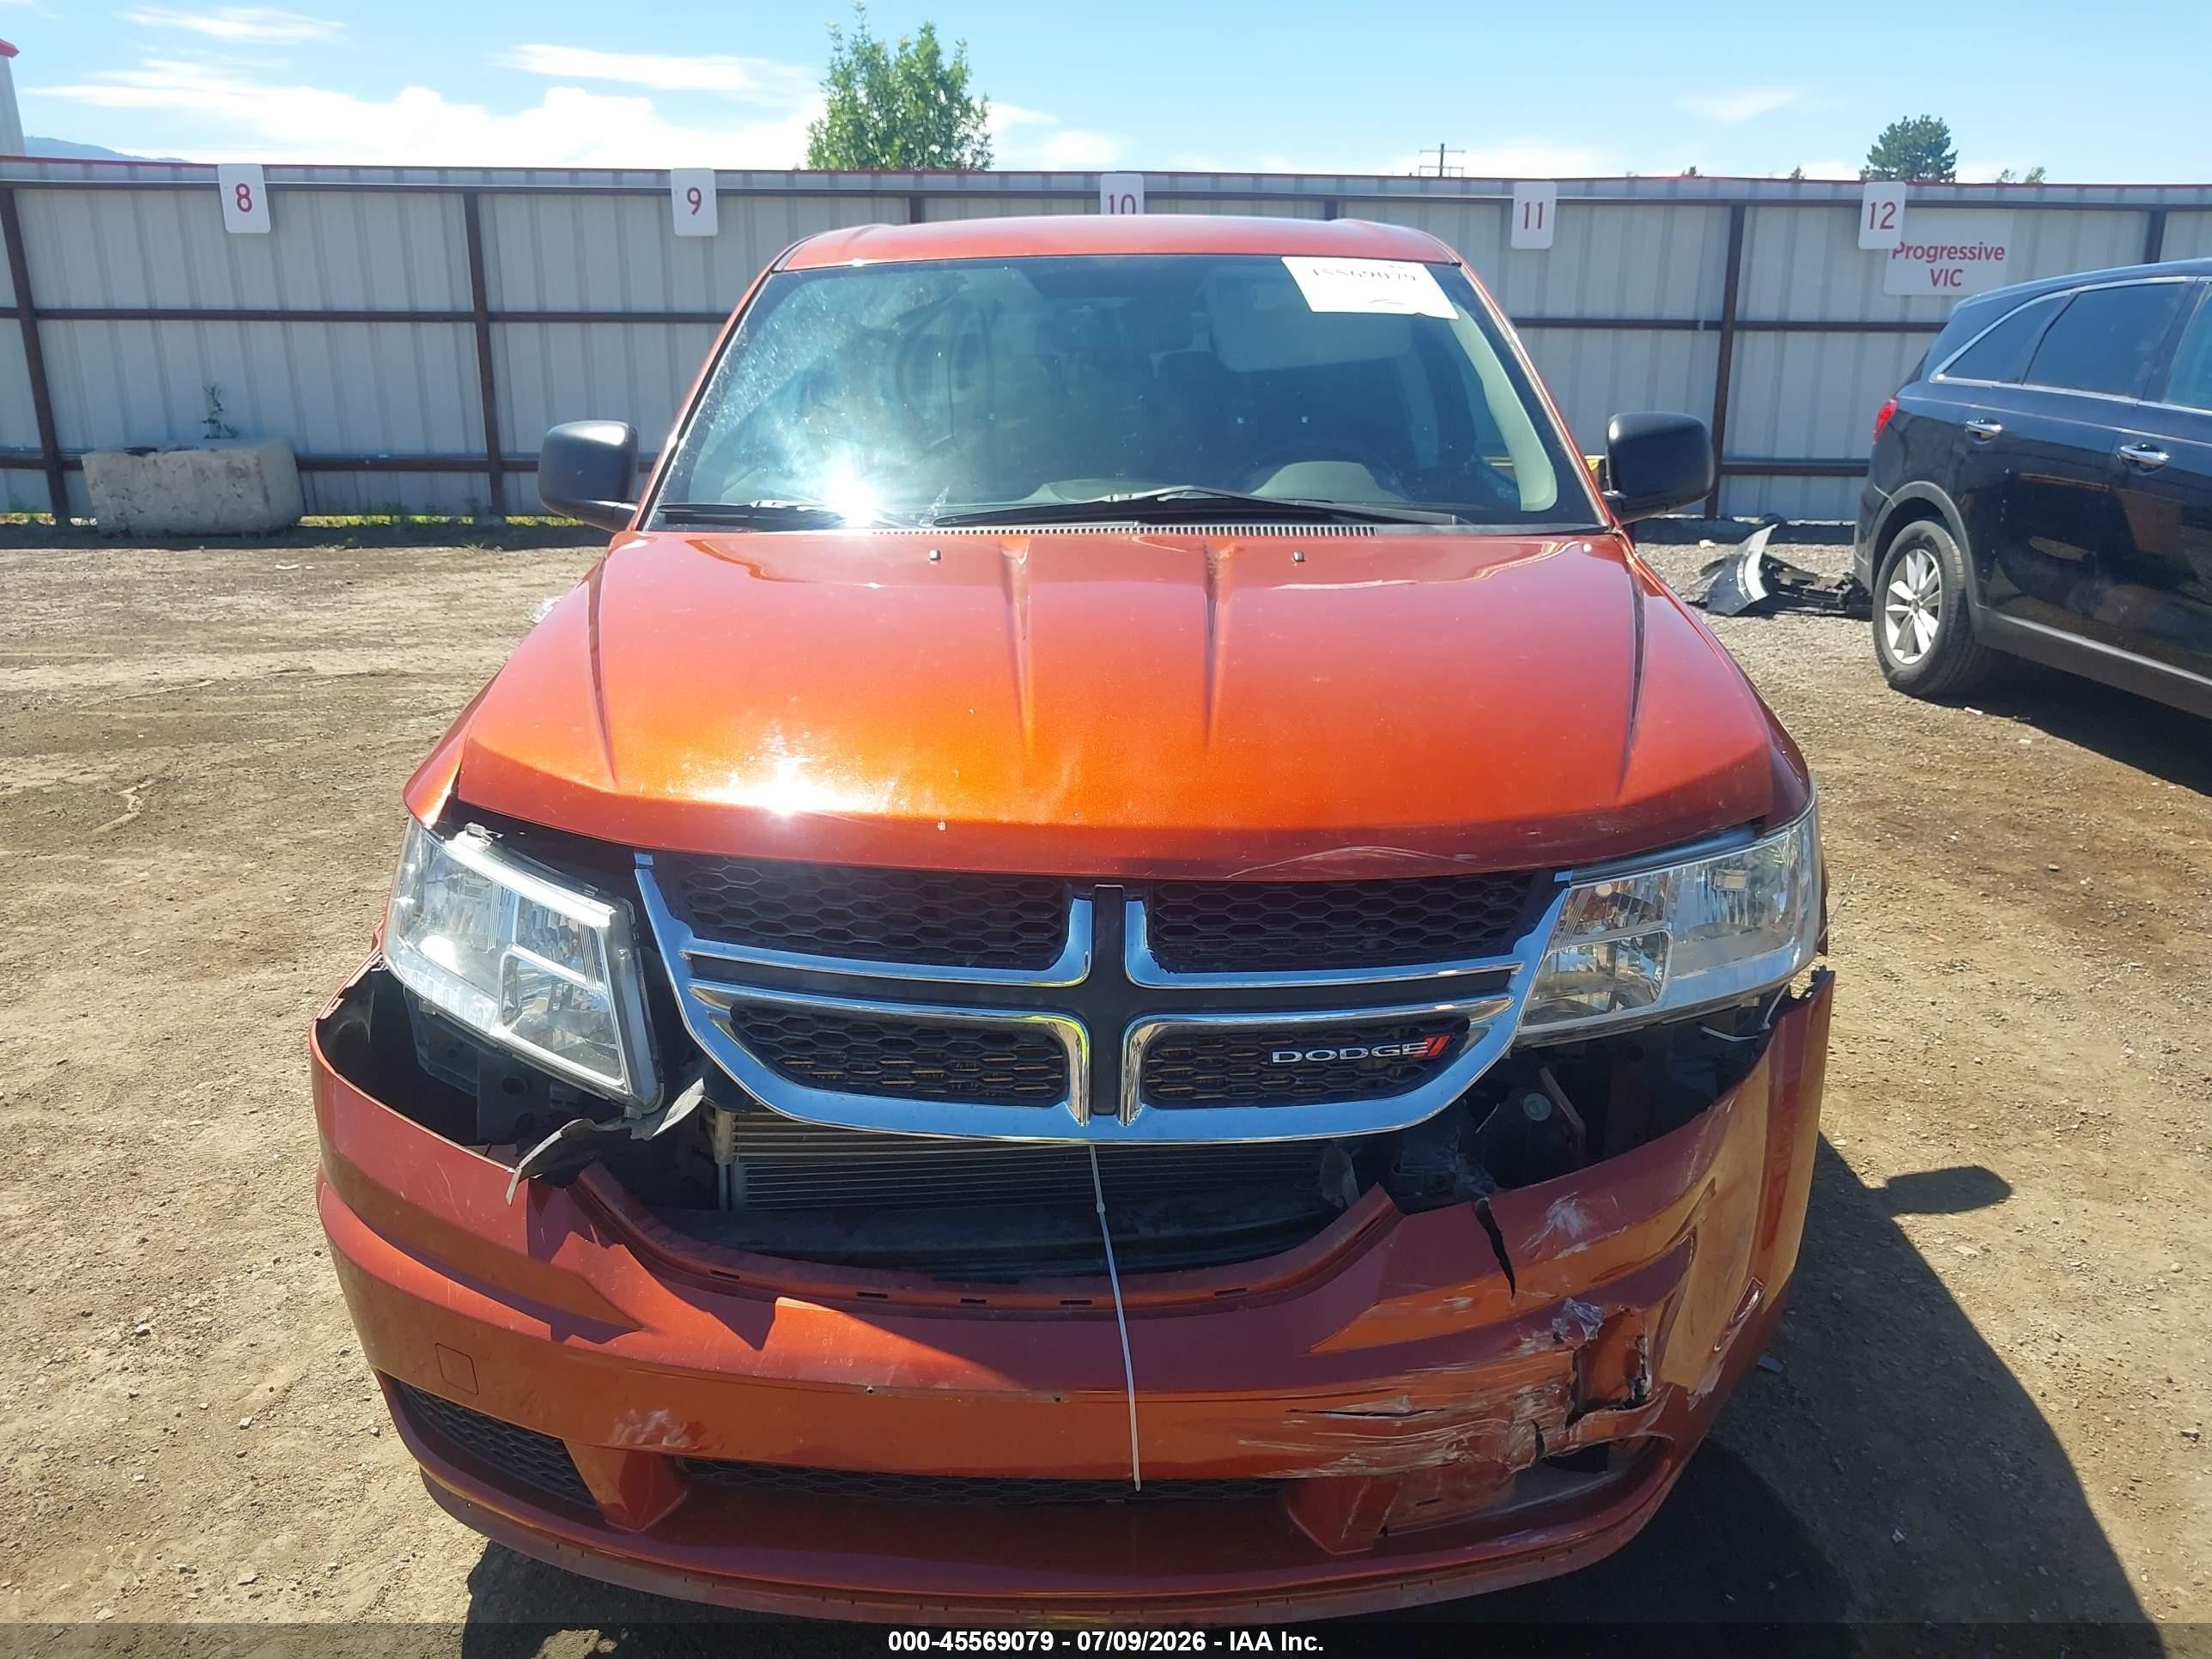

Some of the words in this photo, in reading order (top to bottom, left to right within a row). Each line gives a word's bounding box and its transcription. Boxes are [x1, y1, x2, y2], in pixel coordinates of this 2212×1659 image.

[235, 182, 253, 213] 8
[687, 186, 702, 216] 9
[1109, 194, 1136, 215] 10
[1524, 201, 1544, 230] 11
[1869, 201, 1897, 230] 12
[1892, 241, 2006, 264] Progressive
[1929, 268, 1964, 288] VIC
[1272, 1042, 1429, 1063] DODGE
